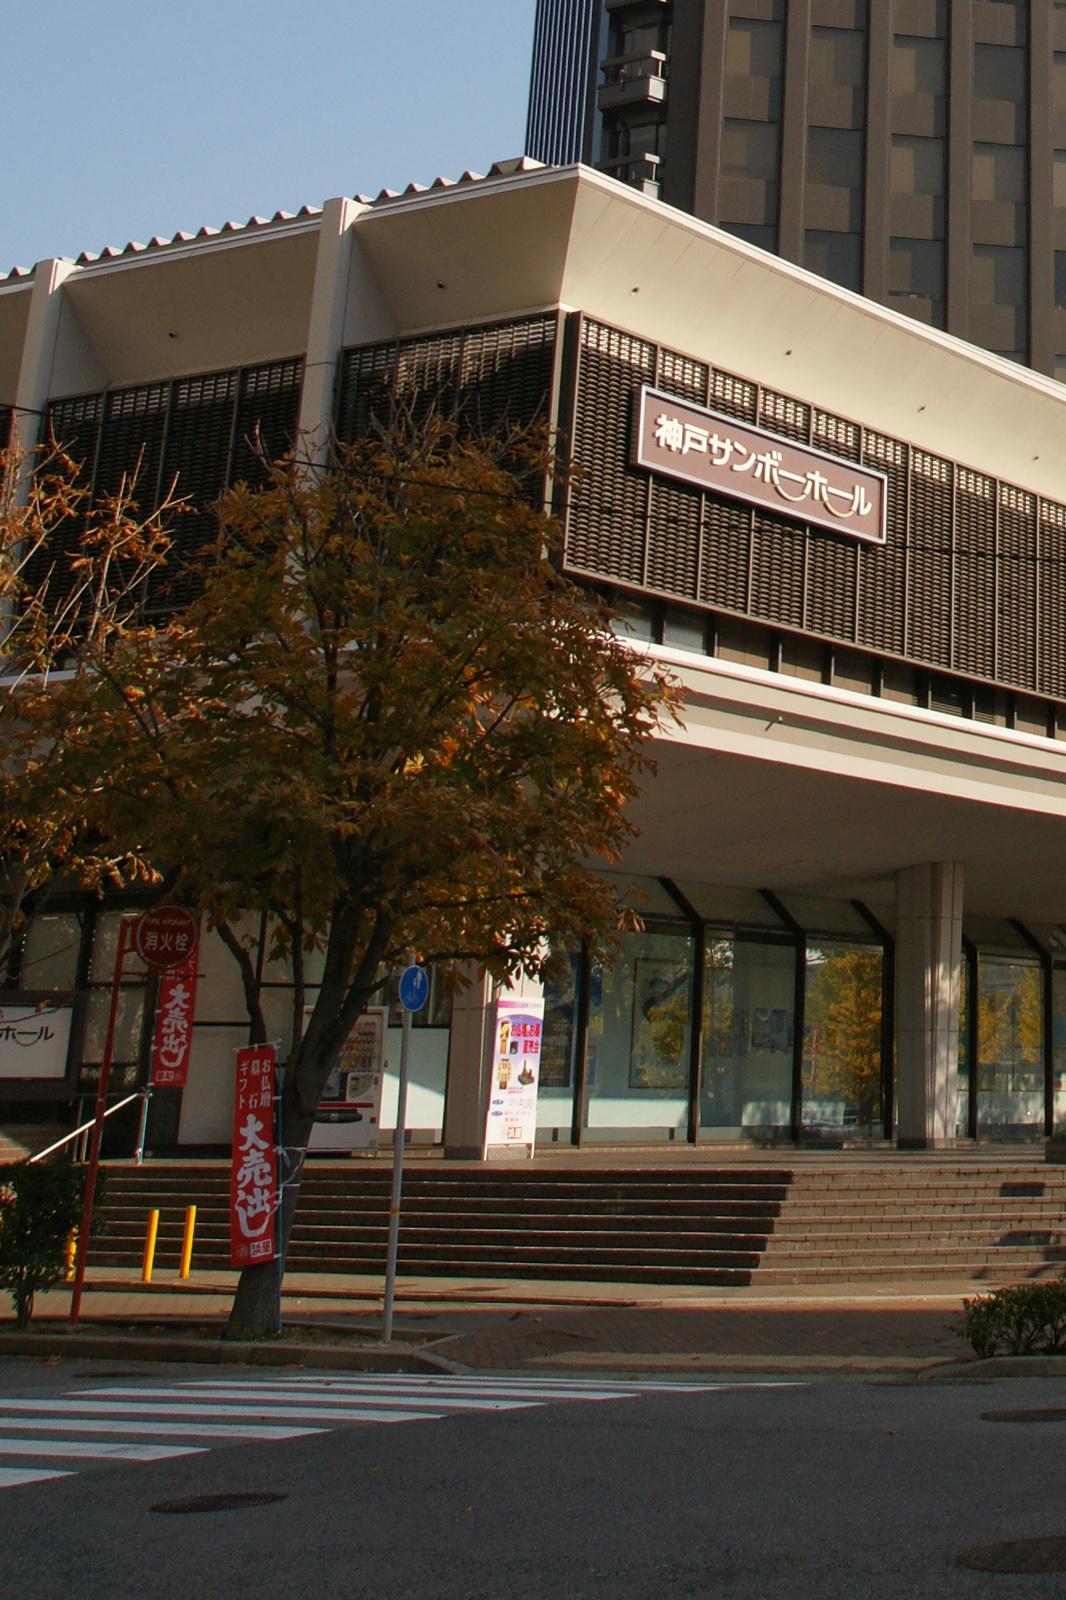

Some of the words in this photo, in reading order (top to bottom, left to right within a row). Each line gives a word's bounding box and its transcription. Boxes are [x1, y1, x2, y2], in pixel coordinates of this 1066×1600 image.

[653, 413, 872, 518] 神戸サンボーホール
[144, 931, 189, 951] 消火栓
[239, 1060, 250, 1109] ギフト
[235, 1113, 273, 1238] 大売出し
